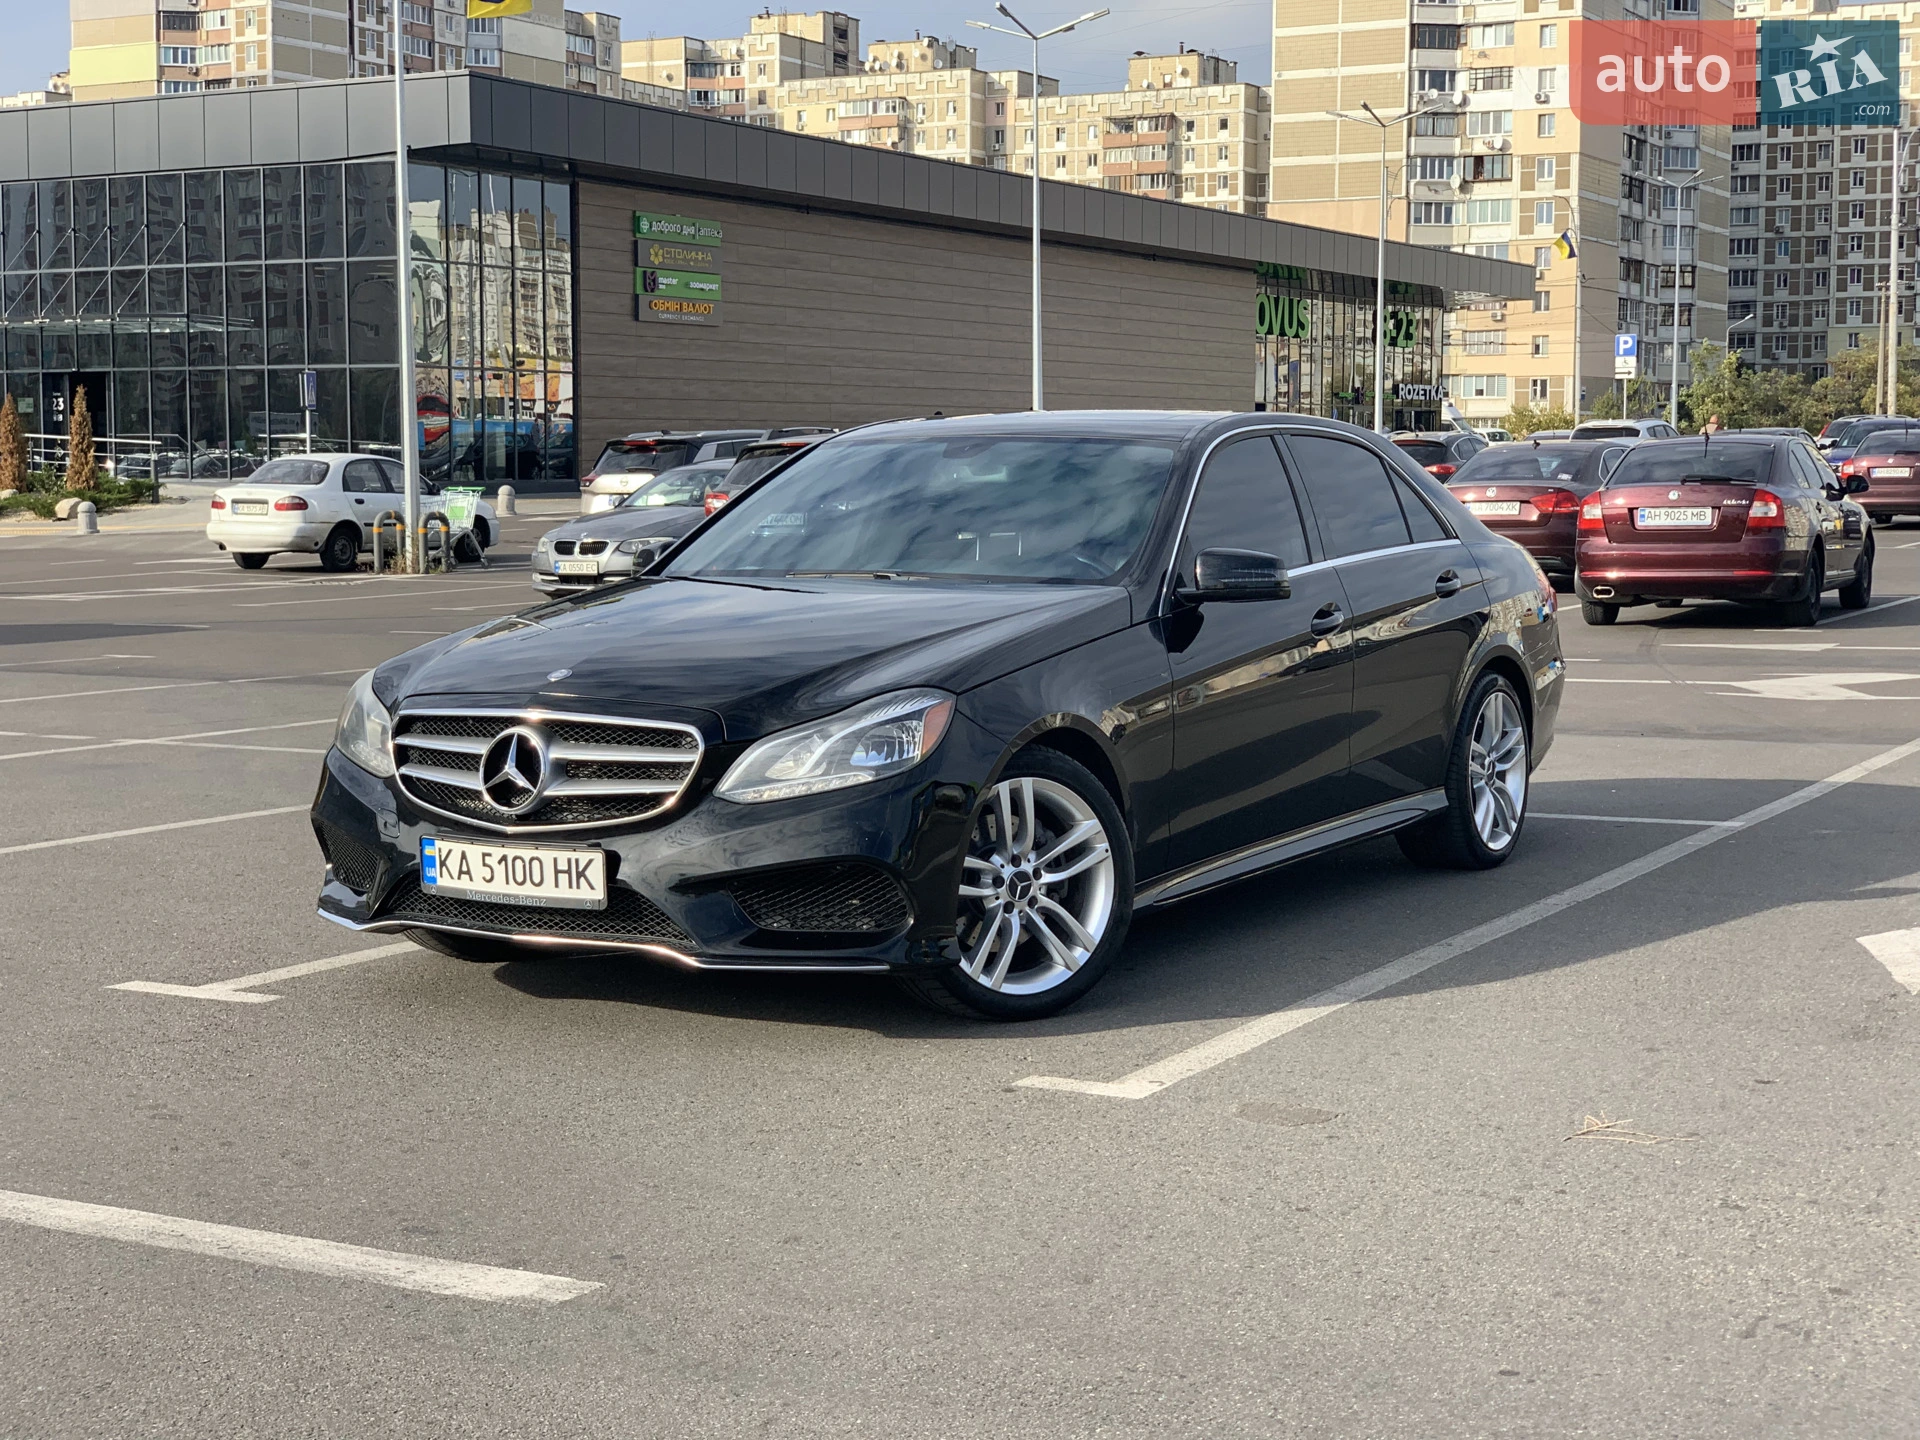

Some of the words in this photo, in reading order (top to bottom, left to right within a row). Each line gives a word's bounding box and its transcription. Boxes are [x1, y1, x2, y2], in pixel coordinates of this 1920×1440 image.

[652, 221, 681, 236] доброго
[682, 224, 695, 236] дня
[699, 227, 723, 239] аптека
[652, 300, 680, 312] ОБМІН
[683, 303, 714, 315] ВАЛЮТ
[1618, 336, 1633, 355] P
[1398, 383, 1444, 401] ROZETKA
[1646, 510, 1661, 521] AH
[1663, 510, 1688, 521] 9025
[1690, 511, 1707, 521] MB
[426, 866, 436, 878] UA
[438, 847, 474, 883] KA
[481, 851, 545, 888] 5100
[553, 856, 597, 891] HK
[466, 889, 547, 906] Mercedes-Benz
